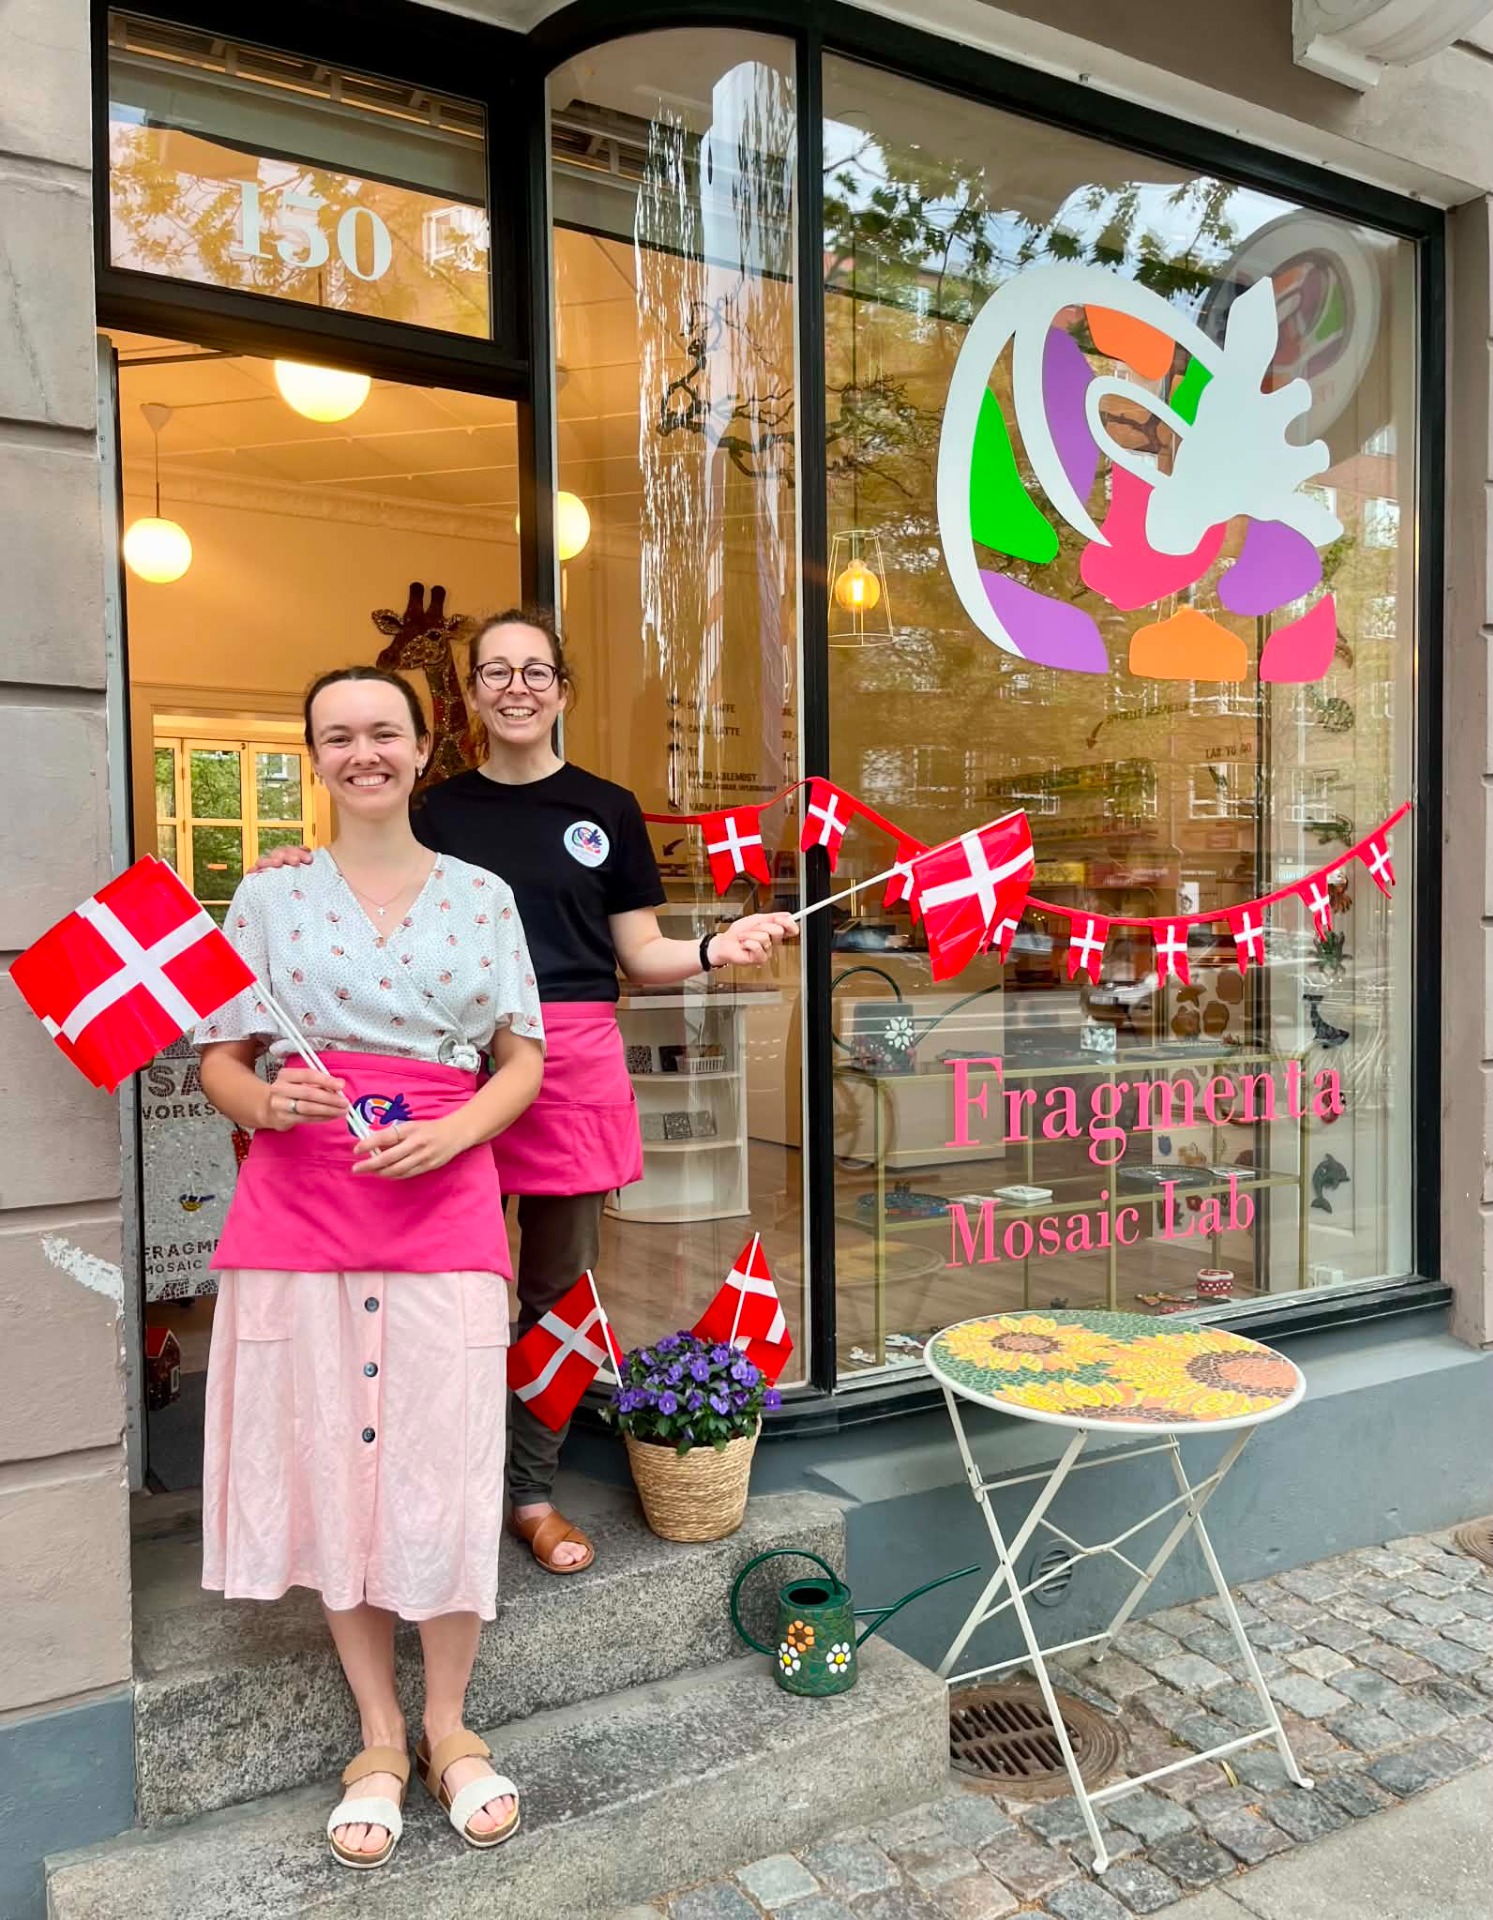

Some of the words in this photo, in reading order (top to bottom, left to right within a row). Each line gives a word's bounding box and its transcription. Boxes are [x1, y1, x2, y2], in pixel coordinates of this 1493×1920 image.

[229, 180, 392, 282] 150
[715, 725, 741, 737] TTE
[944, 1056, 1344, 1166] Fragmenta
[144, 1239, 219, 1259] FRAGM
[946, 1191, 1139, 1268] Mosaic
[1160, 1174, 1255, 1241] Lab
